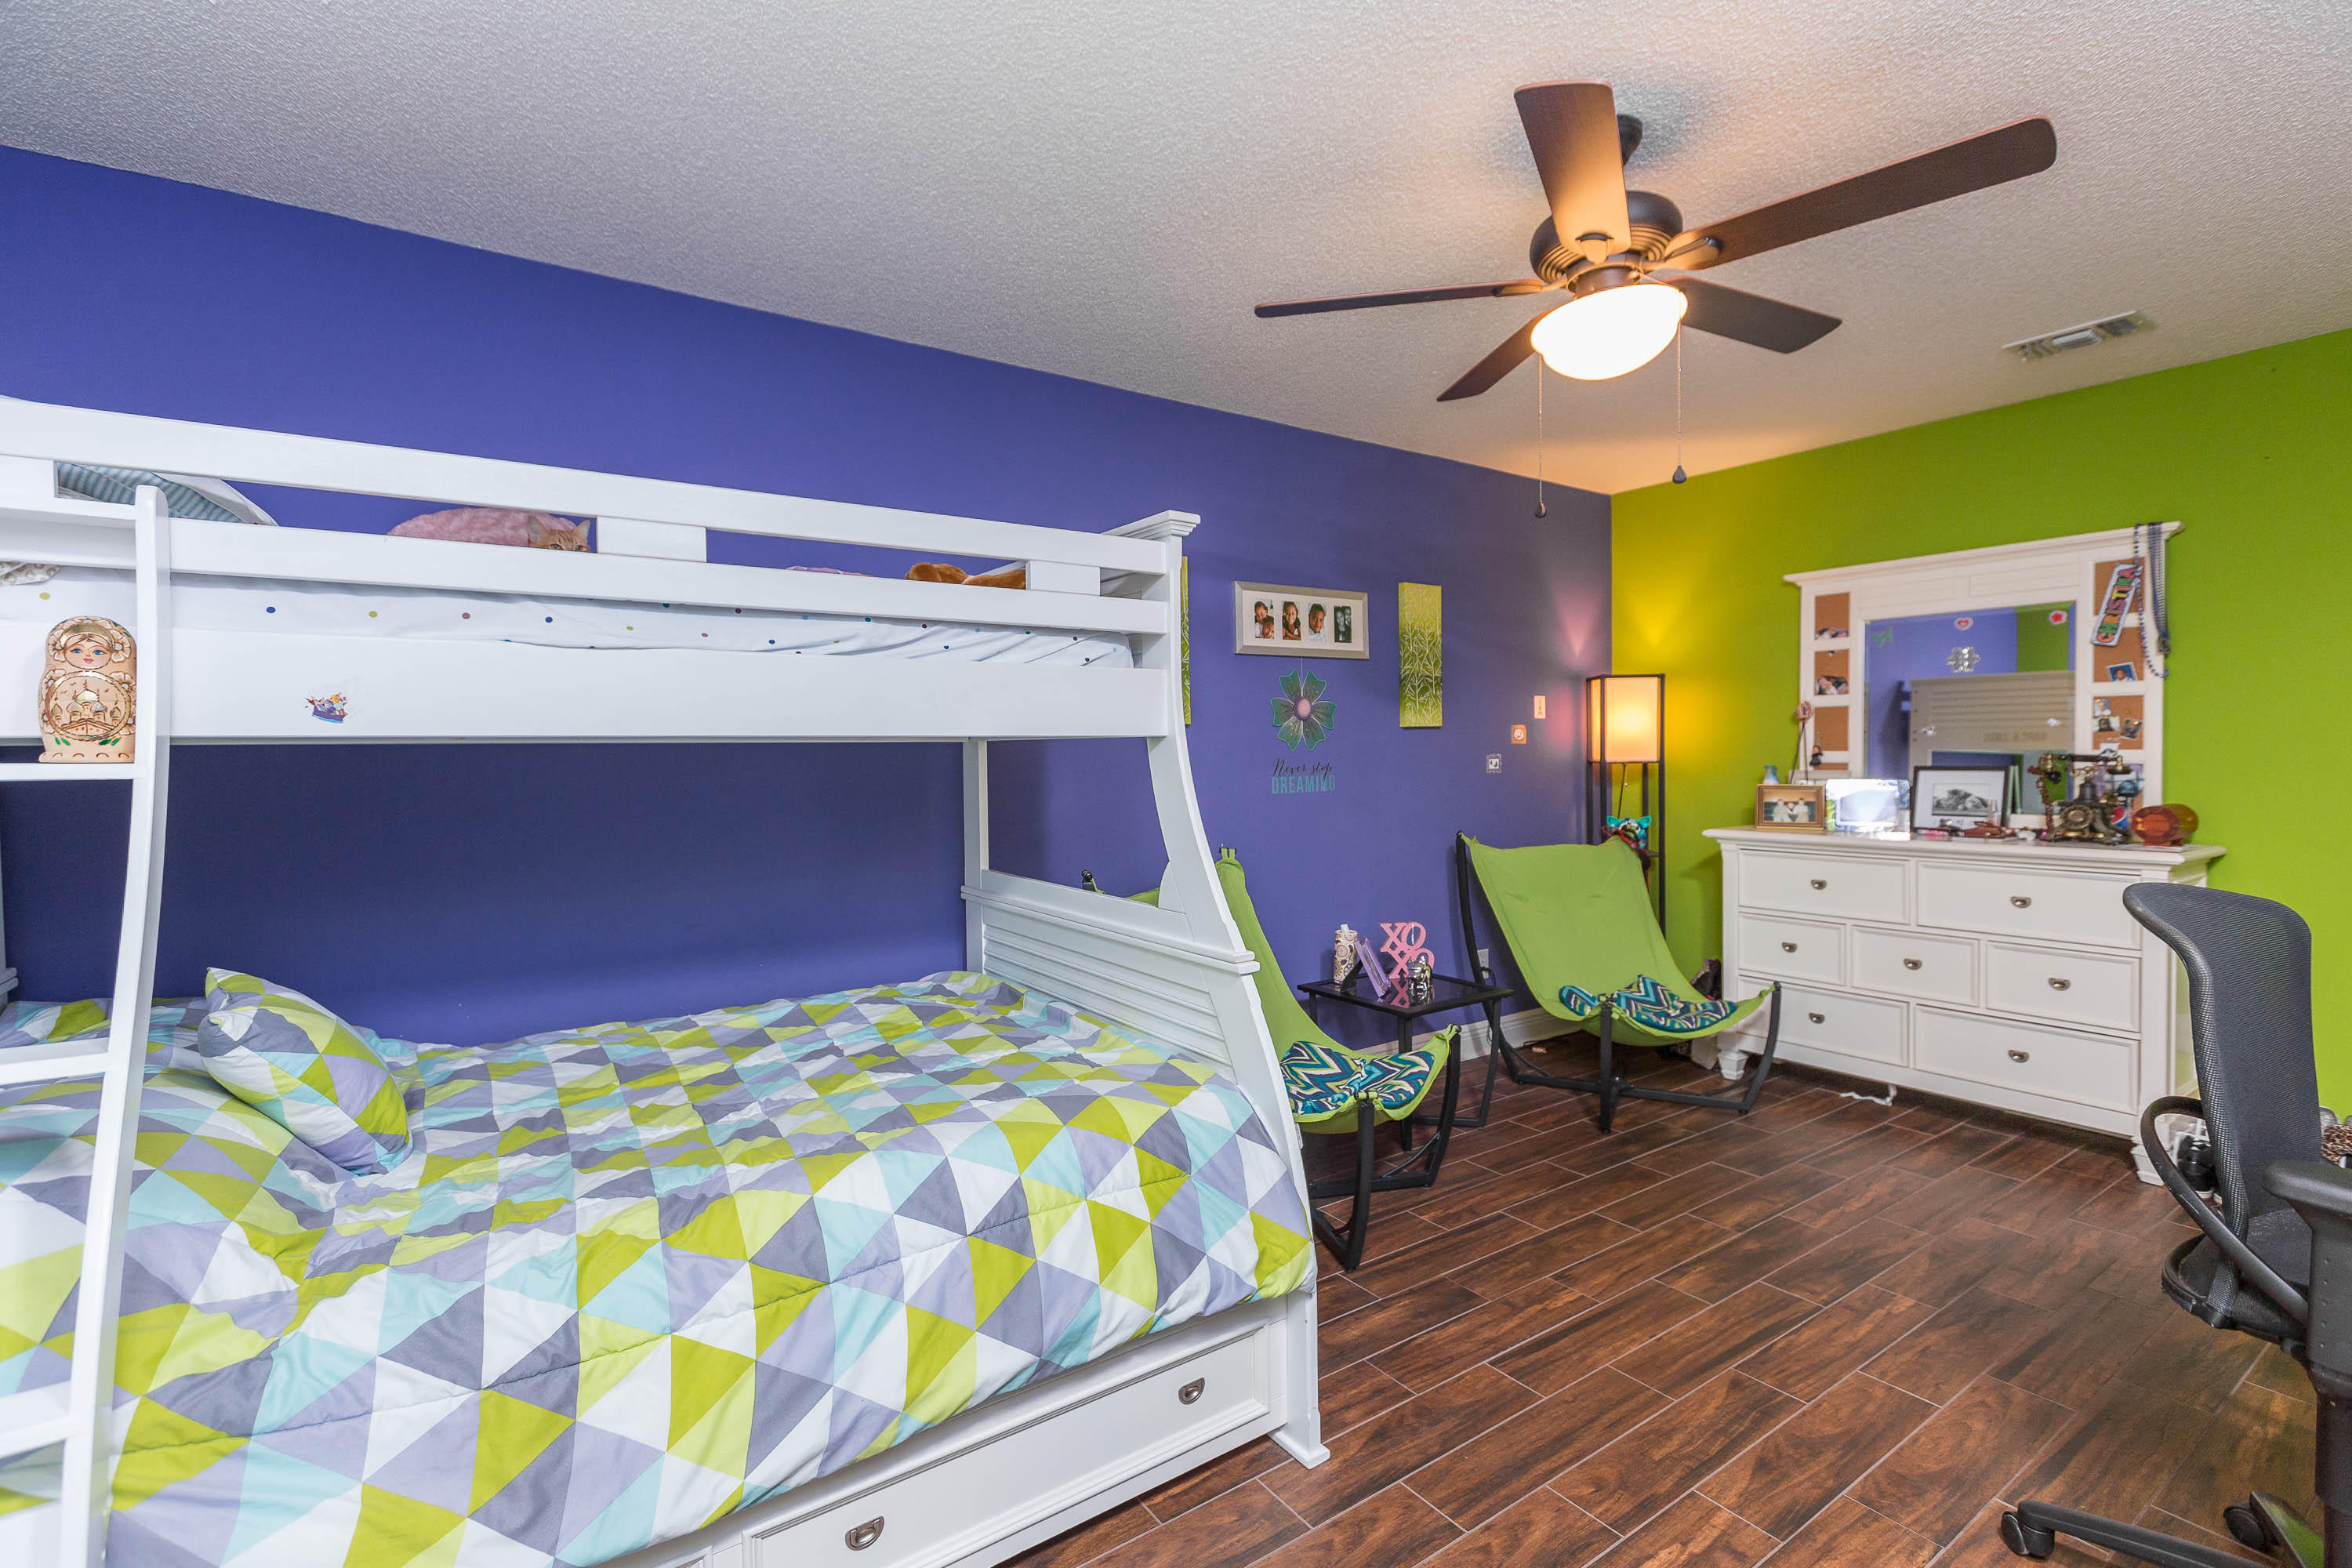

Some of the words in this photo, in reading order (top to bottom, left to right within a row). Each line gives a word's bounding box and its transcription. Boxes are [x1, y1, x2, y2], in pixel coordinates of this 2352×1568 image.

[1273, 757, 1308, 776] Never
[1312, 760, 1334, 781] stop
[1272, 775, 1336, 794] DREAMING
[1380, 922, 1426, 953] XO
